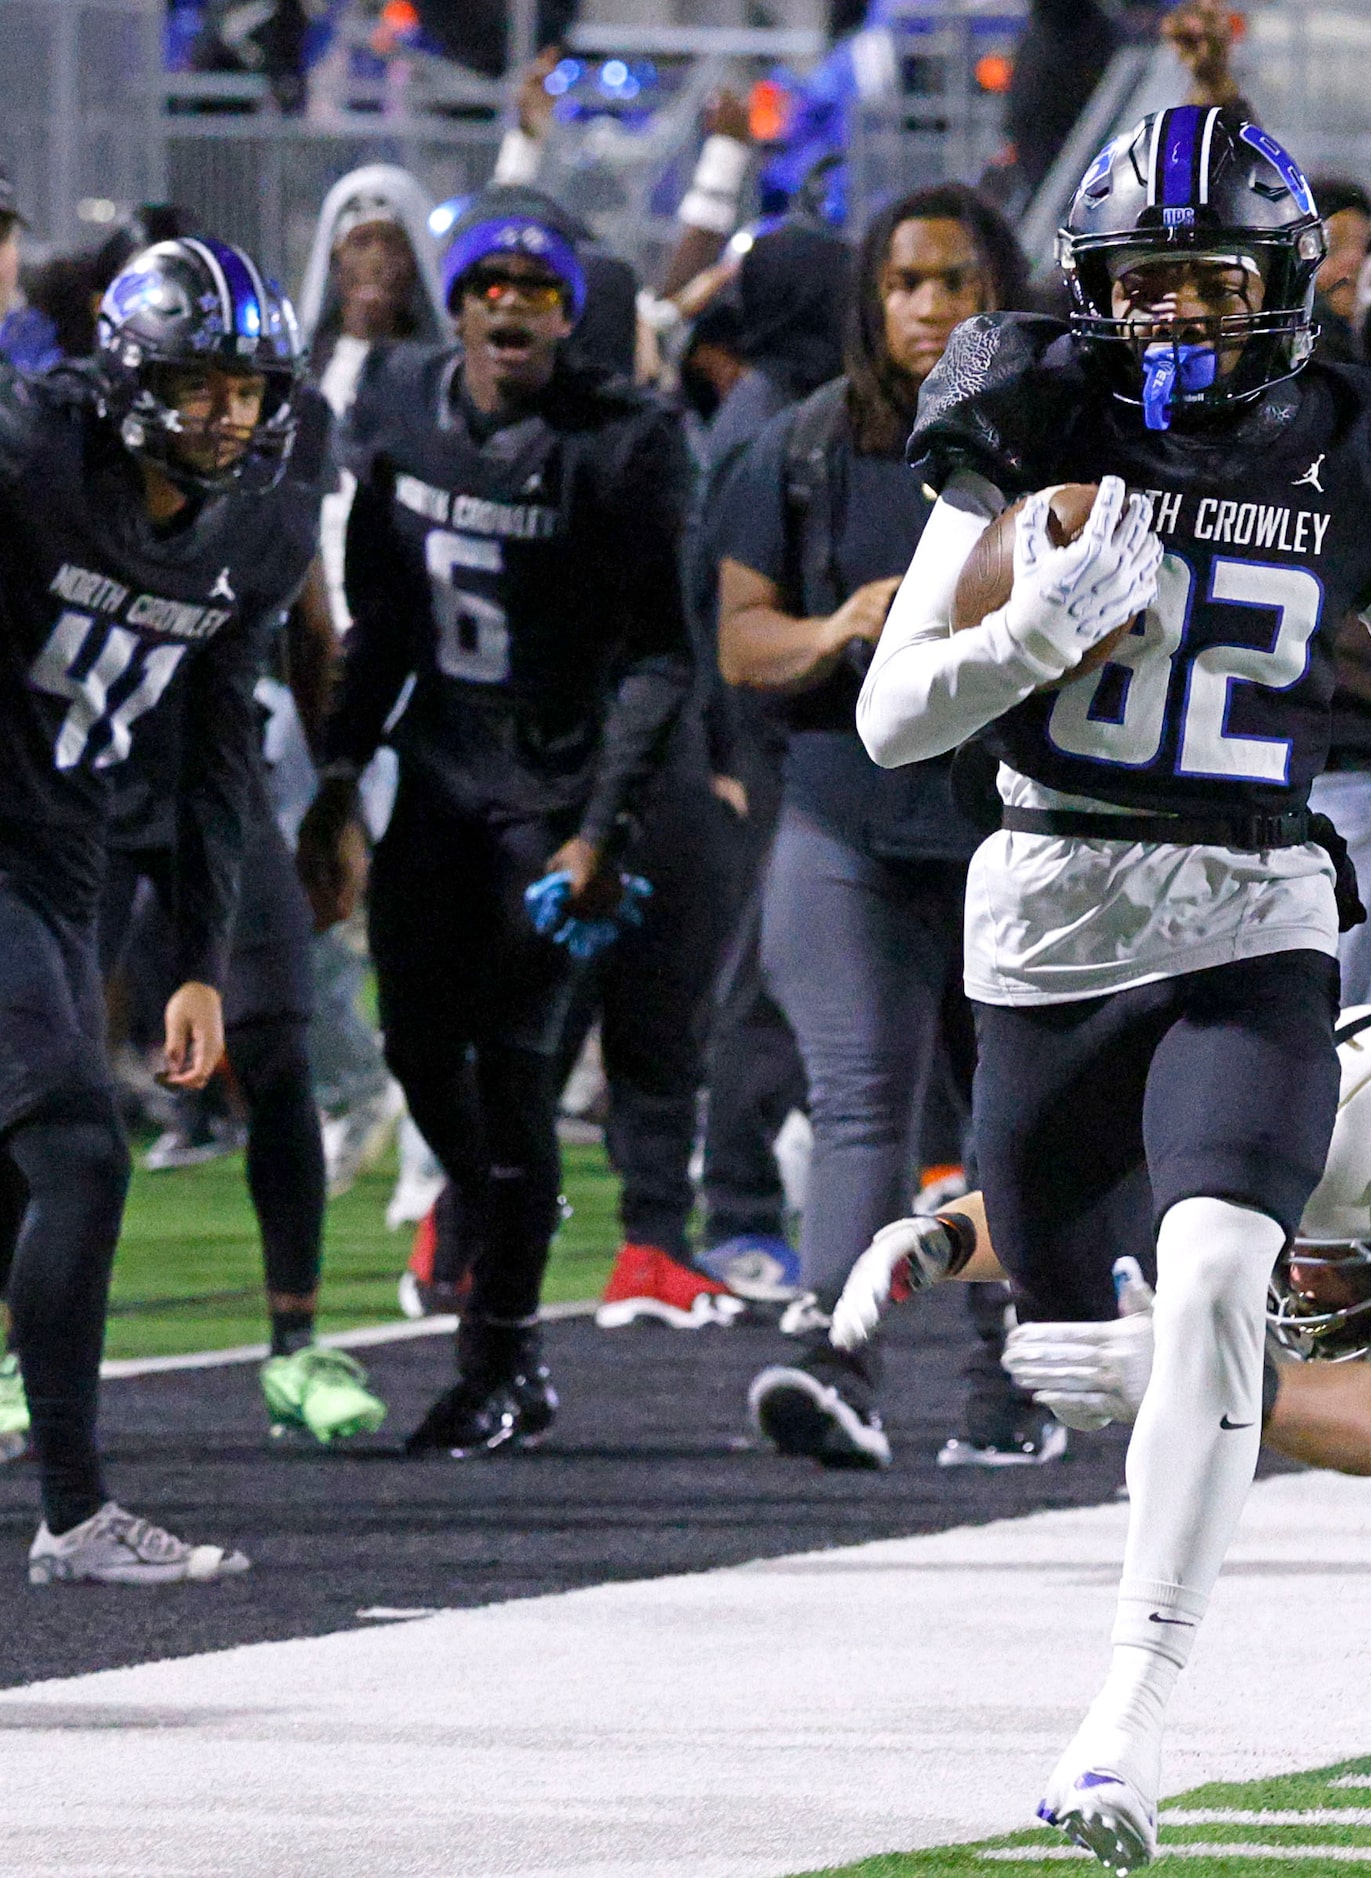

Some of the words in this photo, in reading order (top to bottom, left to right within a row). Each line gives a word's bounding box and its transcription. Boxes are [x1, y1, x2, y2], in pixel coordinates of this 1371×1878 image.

[1194, 498, 1331, 555] CROWLEY
[50, 563, 129, 614] NORTH
[126, 594, 232, 638] CROWLEY
[425, 527, 511, 684] 6
[1047, 553, 1325, 786] 82
